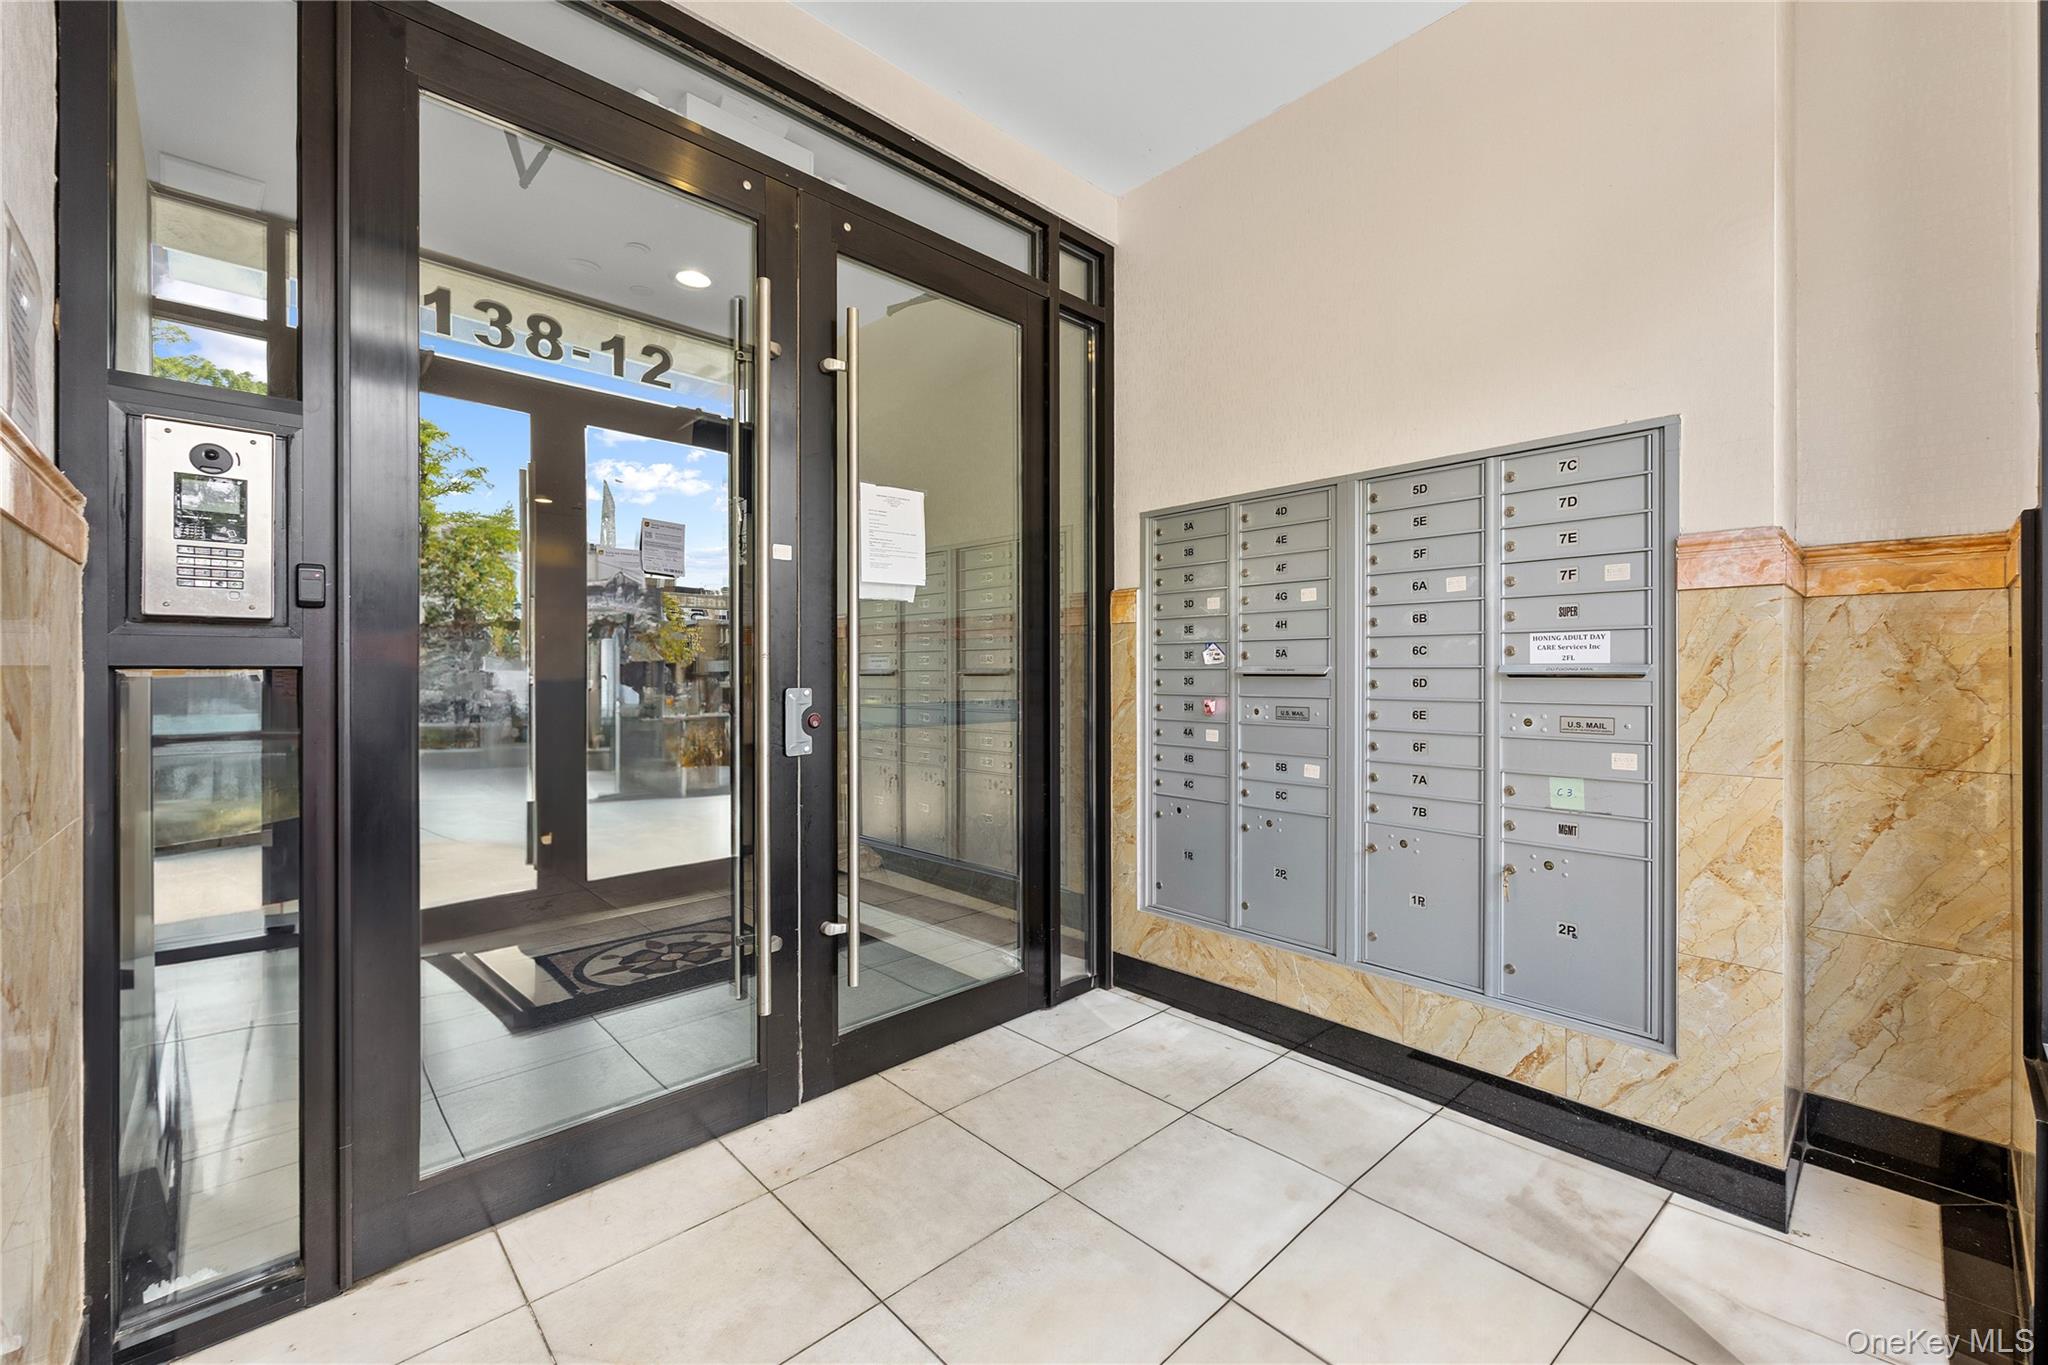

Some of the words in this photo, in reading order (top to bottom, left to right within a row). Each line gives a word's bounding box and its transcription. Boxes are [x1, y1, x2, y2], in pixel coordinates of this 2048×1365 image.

[423, 286, 672, 390] 138-12
[1559, 460, 1576, 472] 7C
[1413, 484, 1427, 494] 5D
[1559, 497, 1577, 508] 7D
[1276, 506, 1287, 515] 4D
[1413, 516, 1426, 526] 5E
[1184, 522, 1194, 531] 3A
[1276, 535, 1287, 544] 4E
[1560, 533, 1576, 544] 7E
[1184, 547, 1194, 556] 3B
[1414, 549, 1426, 559] 5F
[1276, 563, 1286, 572] 4F
[1184, 573, 1194, 582] 3C
[1560, 569, 1576, 580] 7F
[1413, 581, 1427, 591] 6A
[1275, 591, 1287, 600] 4G
[1184, 599, 1194, 608] 3D
[1559, 606, 1577, 617] SUPER
[1413, 614, 1427, 623] 6B
[1276, 619, 1287, 628] 4H
[1184, 624, 1194, 633] 3E
[1184, 650, 1194, 659] 3F
[1276, 648, 1287, 657] 5A
[1413, 646, 1427, 655] 6C
[1184, 676, 1194, 685] 3G
[1413, 678, 1427, 687] 6D
[1184, 702, 1194, 711] 3H
[1413, 711, 1426, 720] 6E
[1567, 721, 1584, 729] U.S.
[1586, 722, 1607, 730] MAIL
[1184, 727, 1194, 736] 4A
[1413, 743, 1426, 752] 6F
[1184, 754, 1194, 763] 4B
[1276, 762, 1287, 771] 5B
[1413, 775, 1427, 784] 7A
[1184, 780, 1194, 789] 4C
[1276, 791, 1287, 800] 5C
[1412, 807, 1426, 817] 7B
[1559, 824, 1577, 836] MGMT
